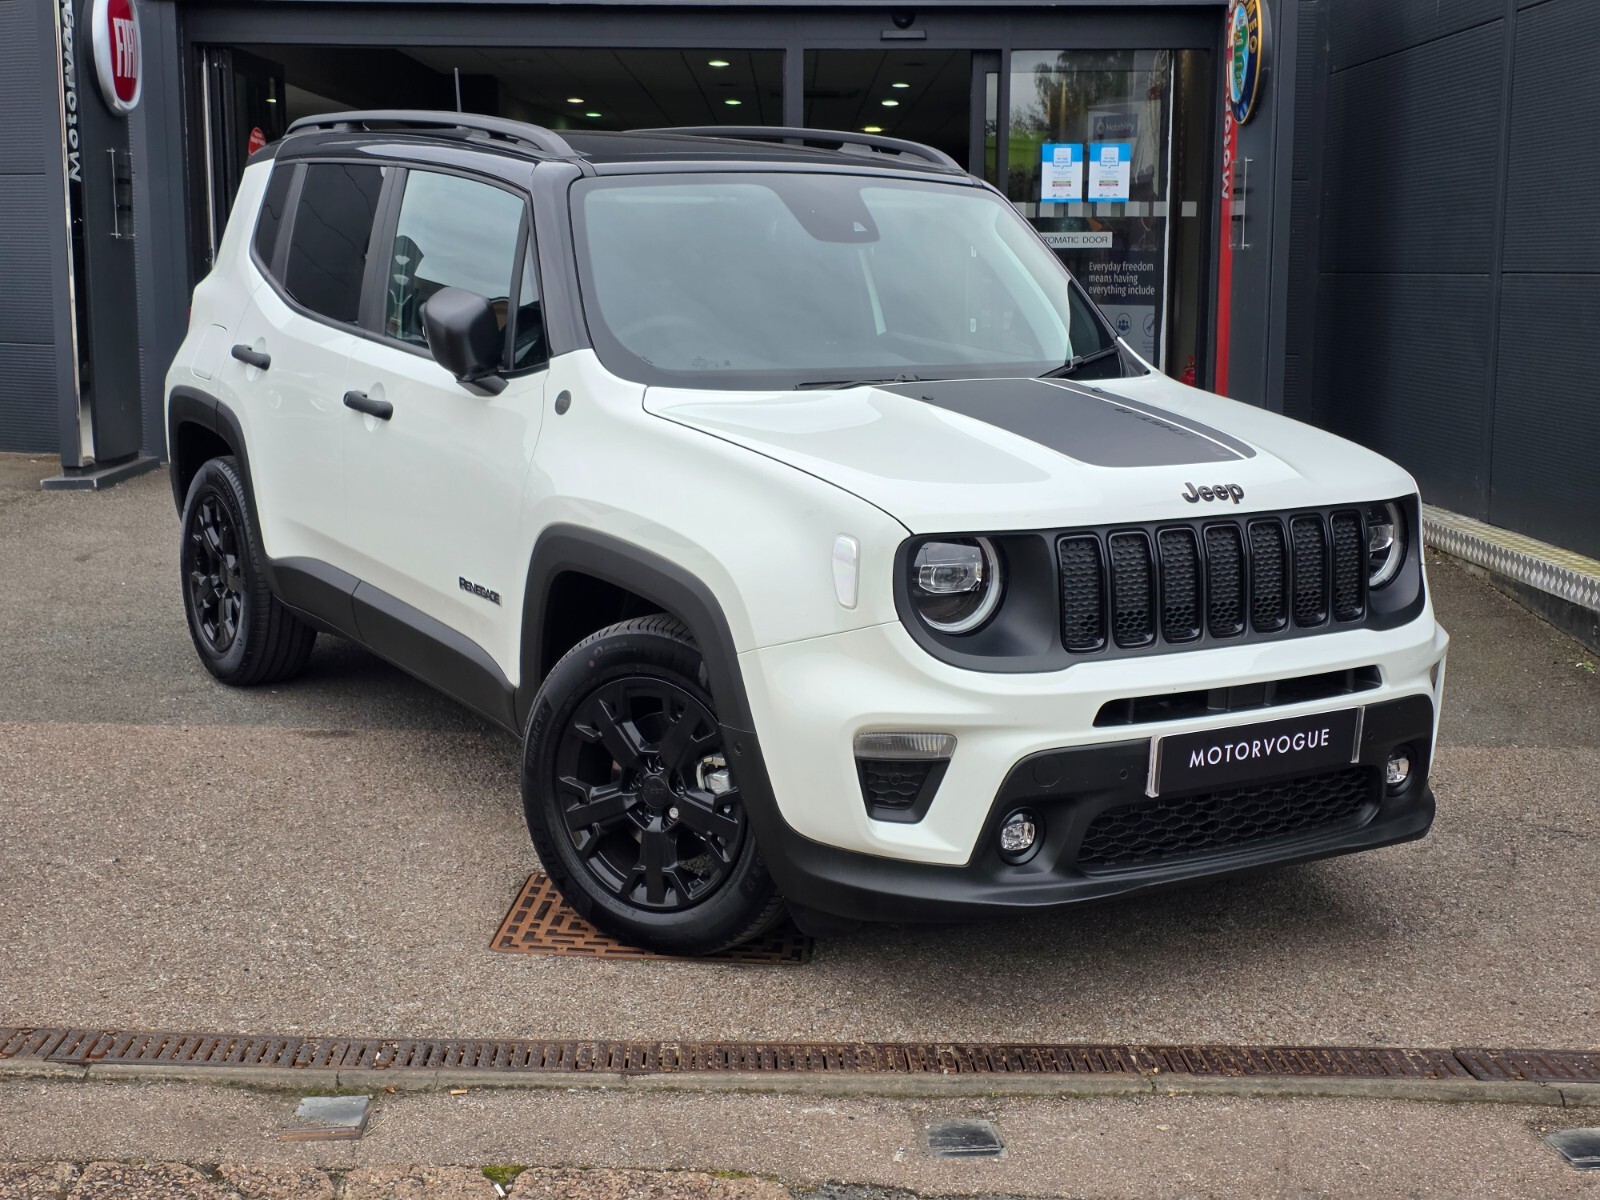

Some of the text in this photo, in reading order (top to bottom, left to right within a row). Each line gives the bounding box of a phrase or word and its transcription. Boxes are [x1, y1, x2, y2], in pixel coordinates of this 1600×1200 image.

[1082, 236, 1108, 244] DOOR
[1088, 261, 1154, 273] Everyday freedom
[1088, 272, 1138, 286] means having
[1088, 285, 1155, 297] everything include
[1182, 481, 1245, 504] Jeep
[458, 576, 502, 607] RENEGADE
[1189, 728, 1330, 768] MOTORVOGUE
